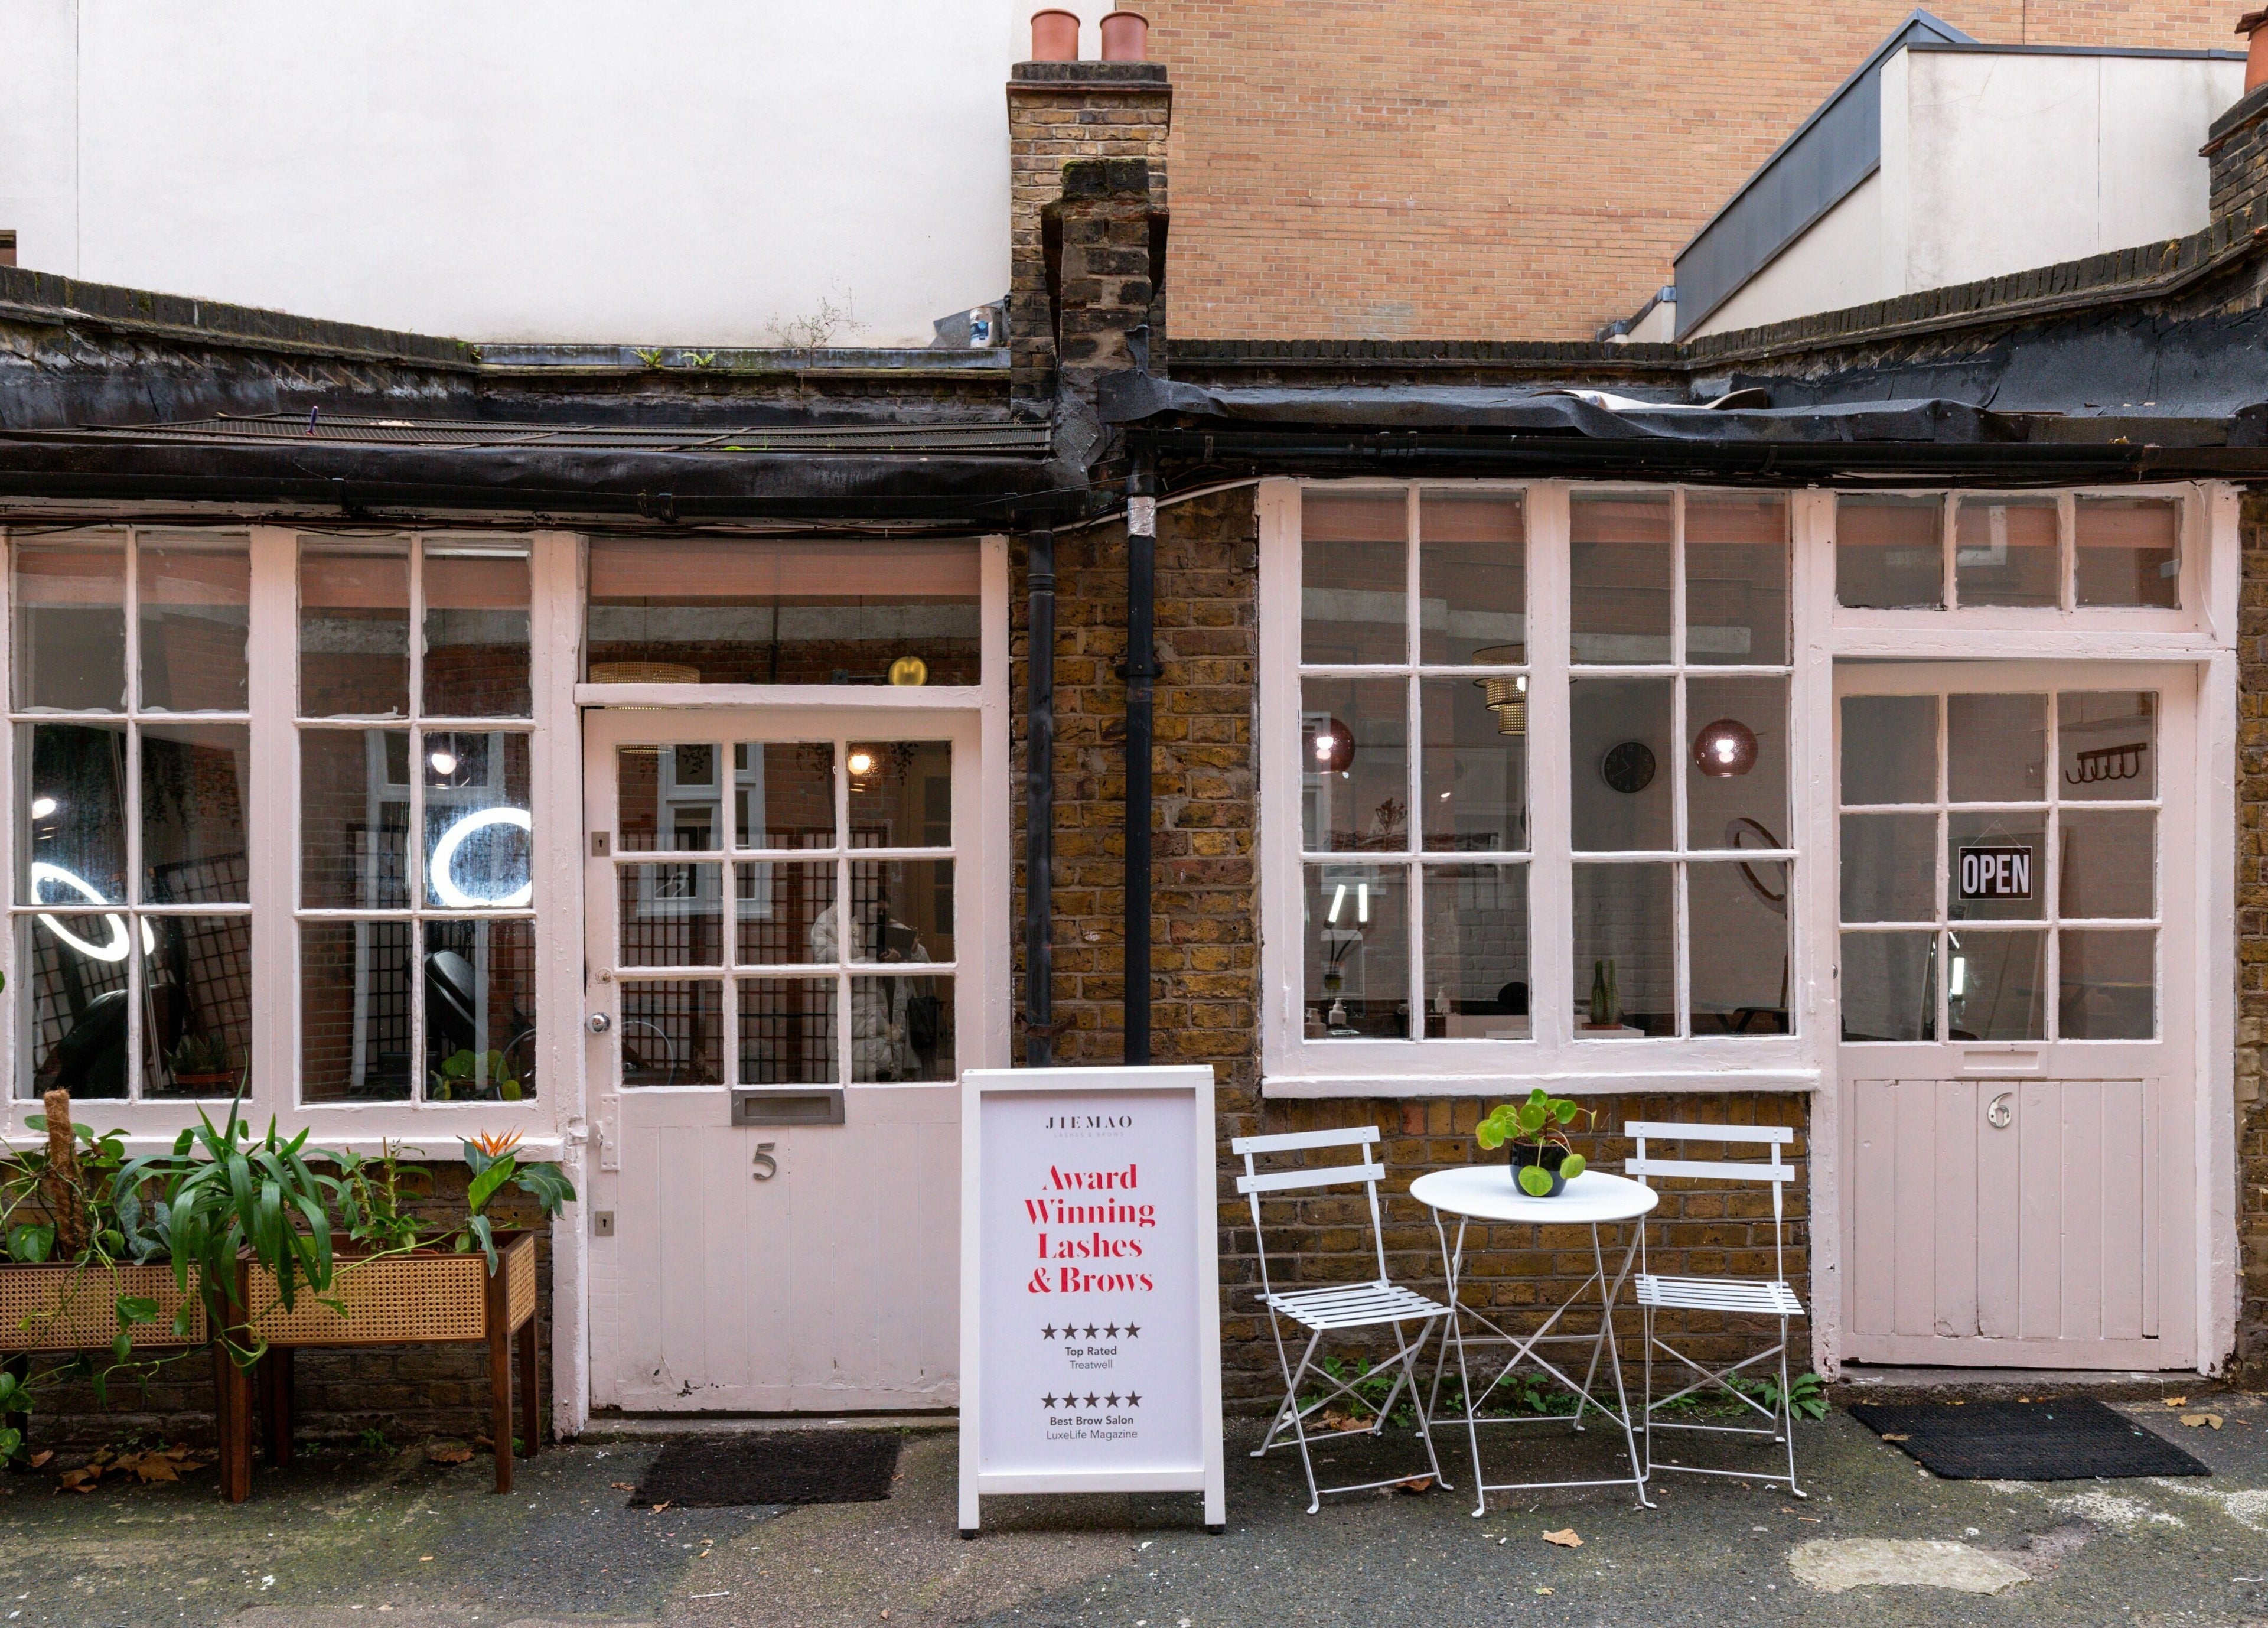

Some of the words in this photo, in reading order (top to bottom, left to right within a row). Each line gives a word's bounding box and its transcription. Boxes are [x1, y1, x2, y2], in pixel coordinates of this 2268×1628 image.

[1963, 854, 2029, 894] OPEN
[1046, 1115, 1132, 1129] JIEMAO
[1987, 1092, 2013, 1129] 6
[752, 1142, 777, 1180] 5
[1042, 1164, 1137, 1190] Award
[1025, 1197, 1156, 1228] Winning
[1038, 1233, 1142, 1259] Lashes
[1028, 1267, 1052, 1294] &
[1060, 1267, 1153, 1293] Brows
[1065, 1347, 1084, 1358] Top
[1087, 1346, 1117, 1356] Rated
[1070, 1359, 1113, 1369] Treatwell
[1050, 1417, 1073, 1426] Best
[1076, 1416, 1103, 1425] Brow
[1106, 1415, 1134, 1425] Salon
[1047, 1429, 1087, 1440] LuxeLife
[1091, 1429, 1138, 1441] Magazine
